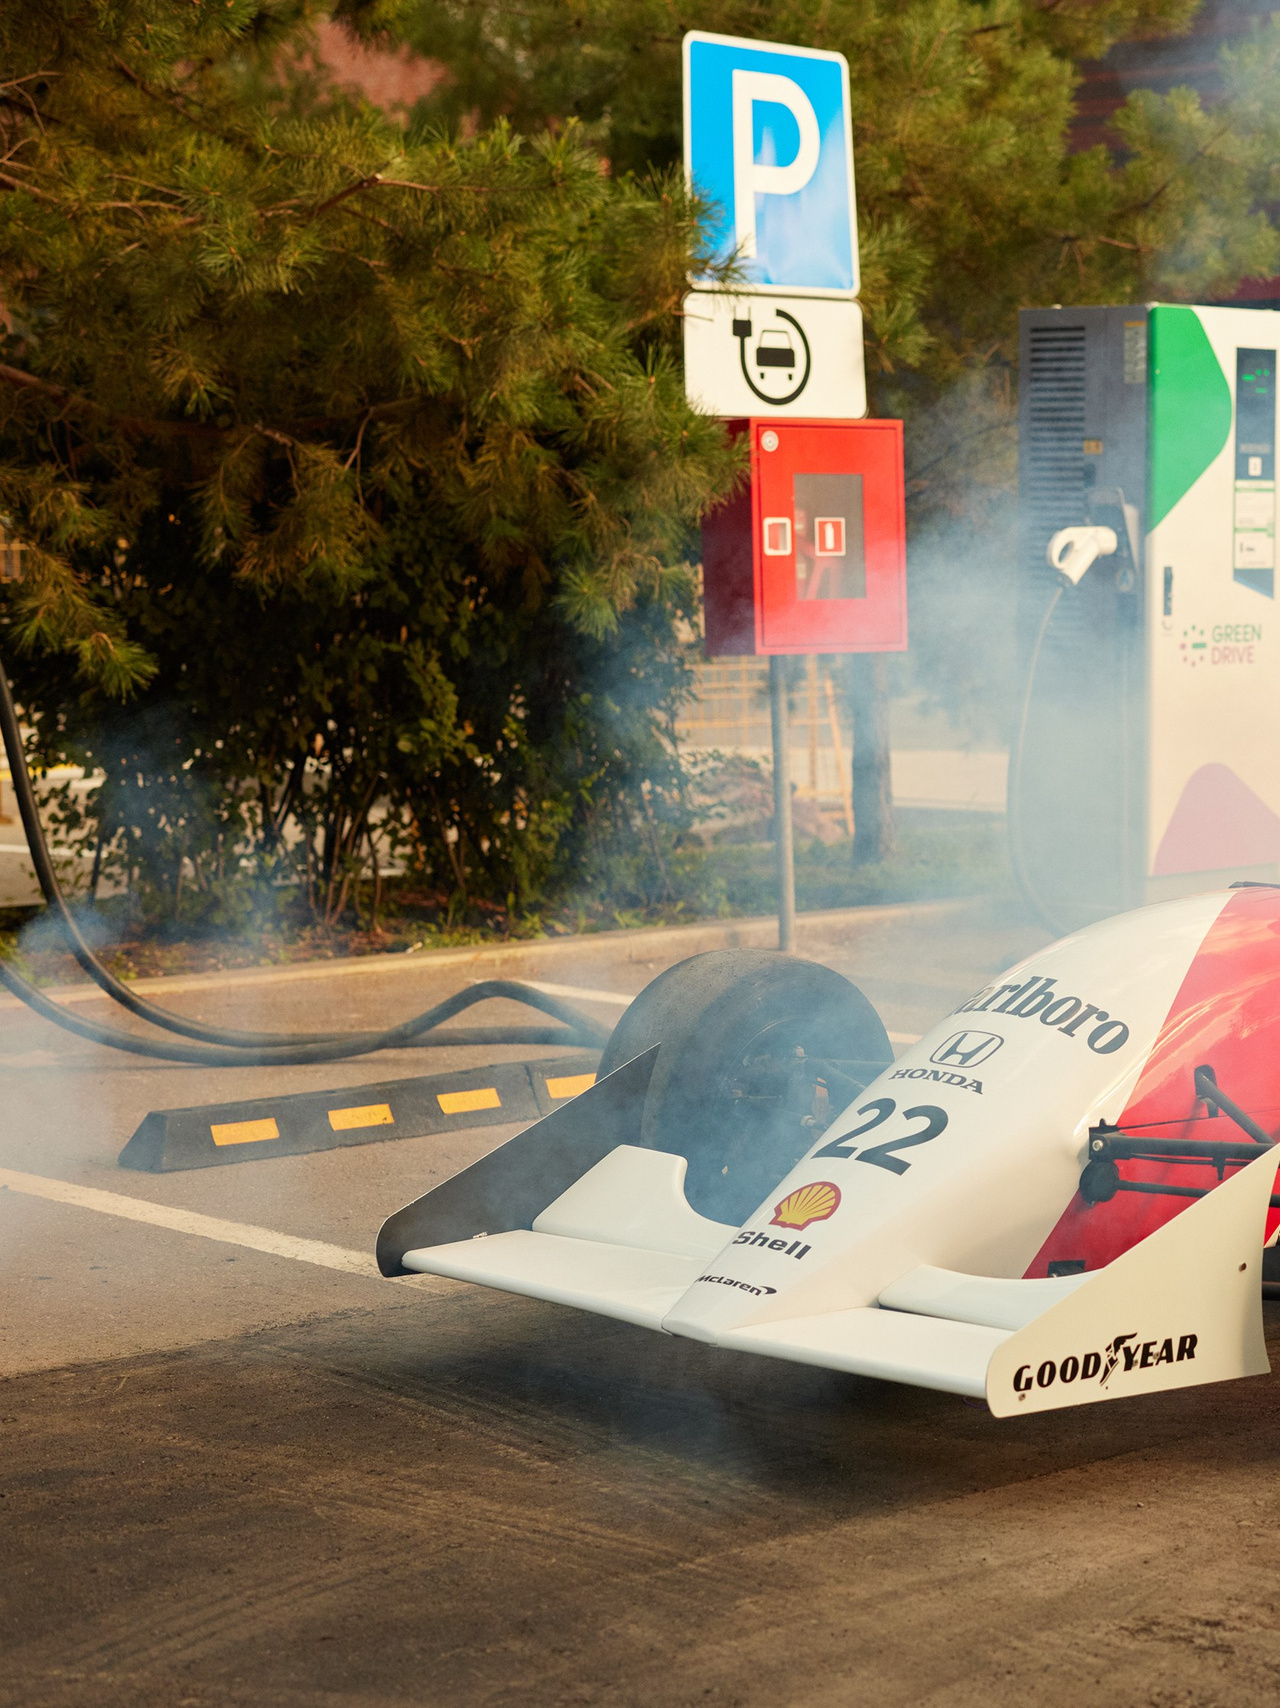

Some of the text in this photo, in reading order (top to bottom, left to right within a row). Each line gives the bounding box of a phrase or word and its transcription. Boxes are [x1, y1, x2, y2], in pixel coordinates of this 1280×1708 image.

[732, 69, 820, 259] P
[1212, 624, 1262, 643] GREEN
[1212, 646, 1254, 665] DRIVE
[953, 976, 1130, 1055] arlboro
[888, 1068, 984, 1095] HONDA
[810, 1098, 949, 1176] 22
[732, 1231, 812, 1260] Shell
